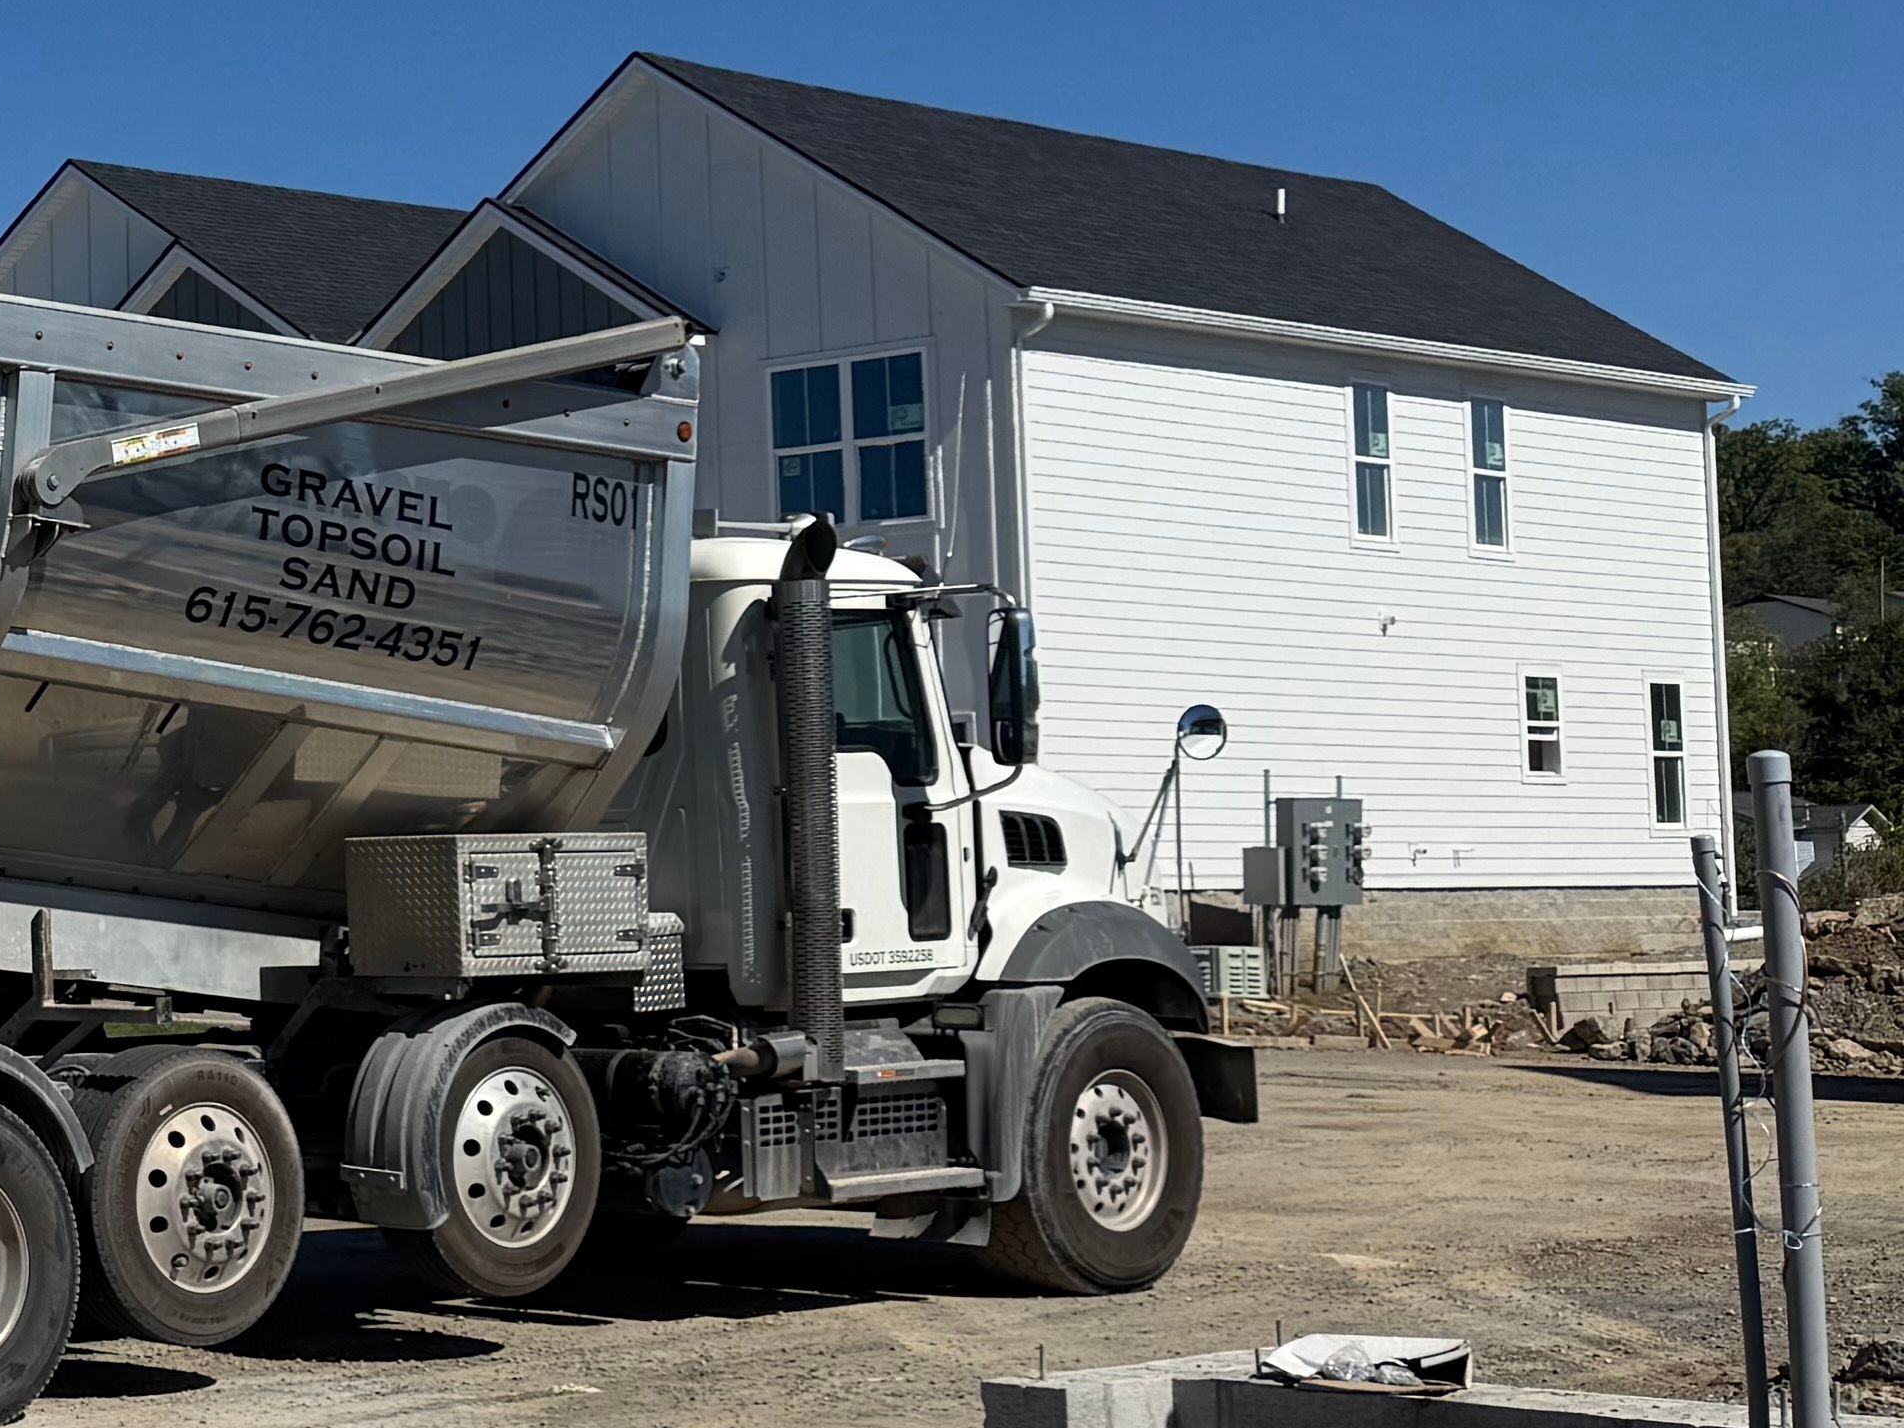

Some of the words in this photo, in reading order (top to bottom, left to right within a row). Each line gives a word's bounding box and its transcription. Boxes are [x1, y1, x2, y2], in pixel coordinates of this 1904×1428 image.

[259, 462, 454, 532] GRAVEL
[571, 471, 639, 530] RS01
[250, 506, 457, 577] TOPSOIL
[279, 556, 417, 611] SAND
[184, 585, 483, 672] 615-762-4351
[850, 951, 885, 966] USDOT
